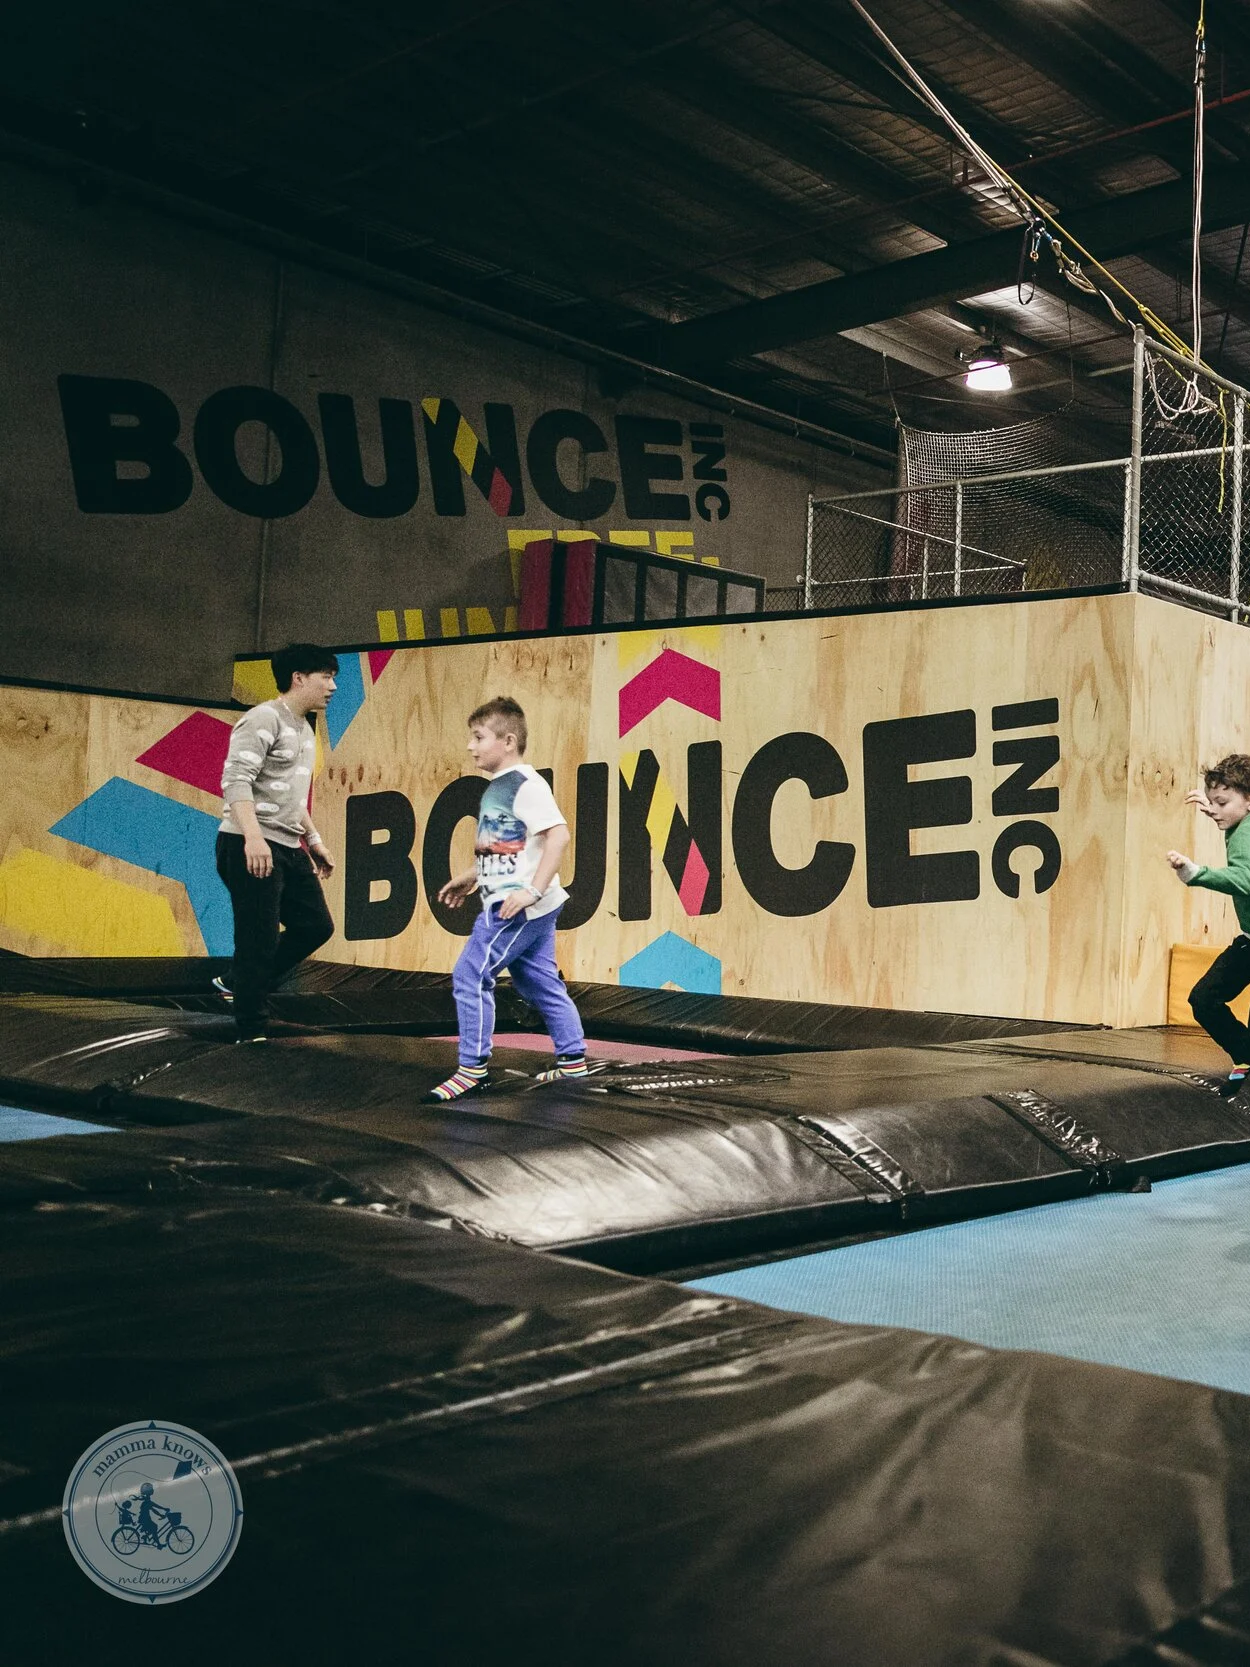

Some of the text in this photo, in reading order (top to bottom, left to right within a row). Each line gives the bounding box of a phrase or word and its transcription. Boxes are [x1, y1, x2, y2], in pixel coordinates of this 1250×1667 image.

[57, 374, 731, 523] BOUNCE INC
[344, 697, 1062, 941] BOUNCE INC
